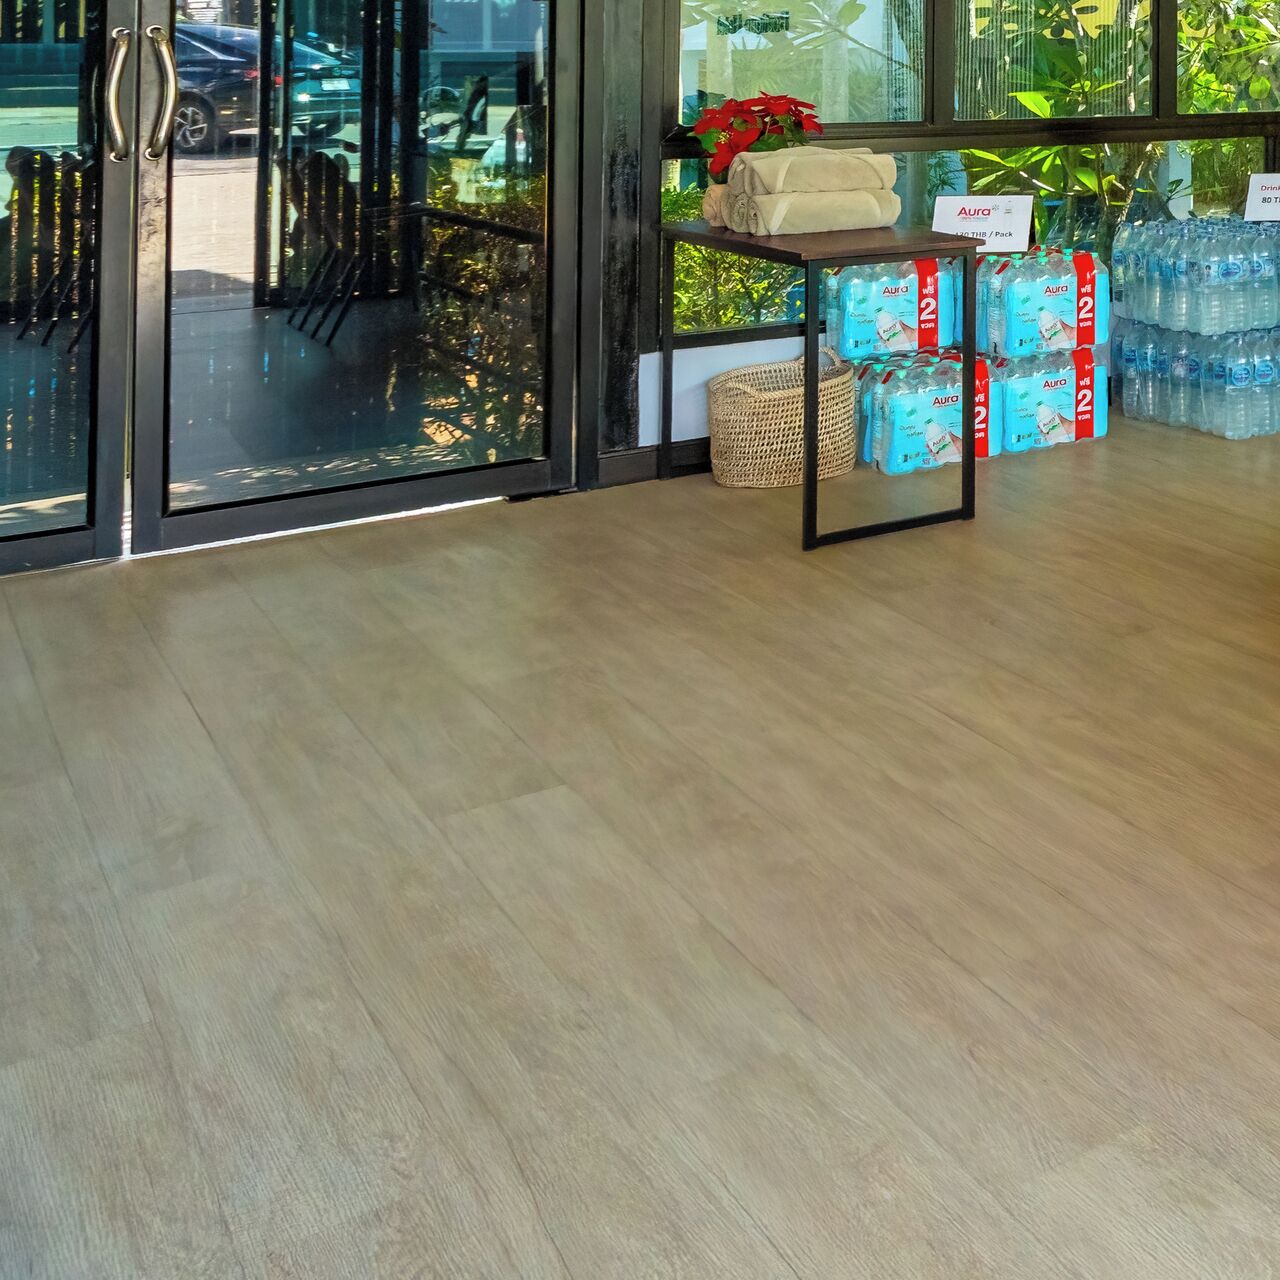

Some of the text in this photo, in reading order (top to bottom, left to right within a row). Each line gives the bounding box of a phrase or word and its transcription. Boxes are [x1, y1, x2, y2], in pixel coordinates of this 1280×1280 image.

[957, 207, 991, 216] Aura
[882, 286, 908, 295] Aura
[1044, 285, 1068, 295] Aura
[920, 298, 936, 320] 2
[1078, 296, 1094, 320] 2
[1043, 379, 1066, 388] Aura
[933, 395, 959, 406] Aura
[1076, 389, 1092, 412] 2
[975, 406, 986, 429] 2
